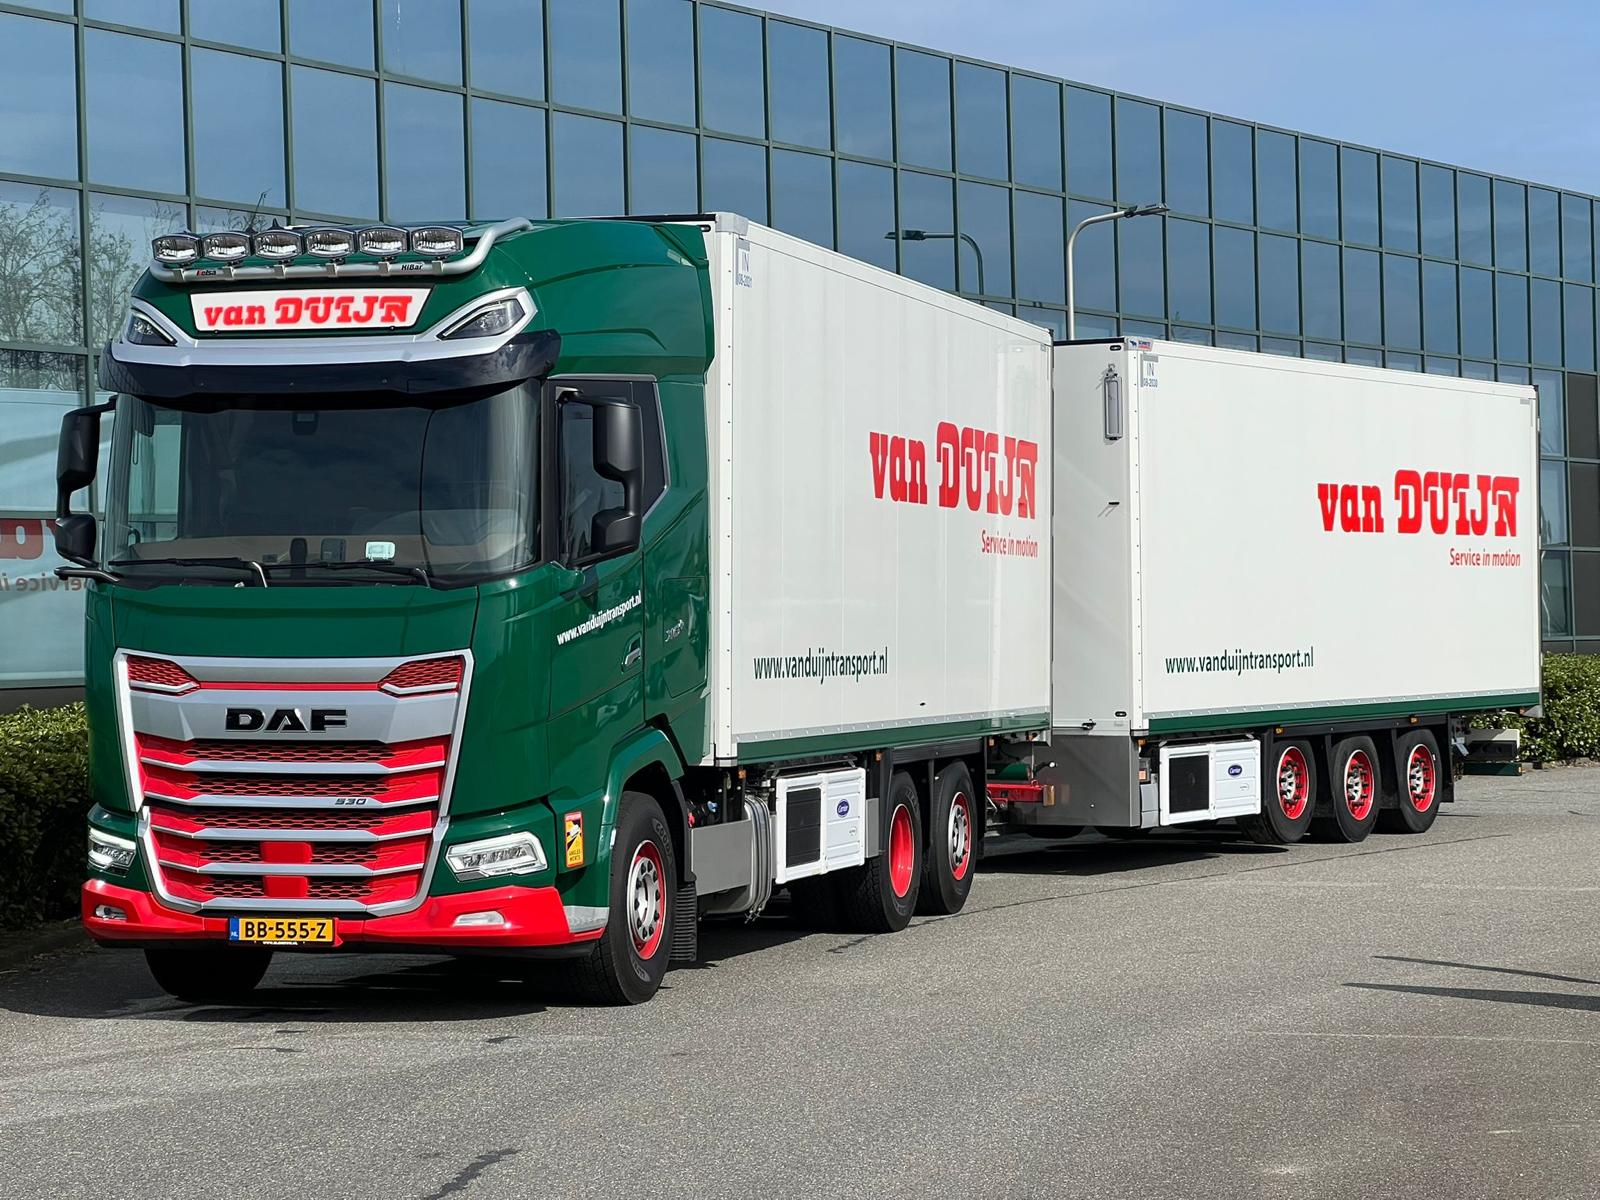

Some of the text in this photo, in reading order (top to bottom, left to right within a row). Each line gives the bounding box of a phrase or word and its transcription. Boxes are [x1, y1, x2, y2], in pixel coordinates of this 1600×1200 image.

[204, 295, 413, 326] van DUIJN
[869, 421, 1038, 520] van DUIJN
[1317, 469, 1520, 537] van DUIJN
[981, 529, 1038, 558] Service in motion
[1449, 547, 1521, 567] Service in motion
[556, 589, 642, 646] www.vanduijntransport.nl
[753, 646, 888, 685] www.vanduijntransport.nl
[1165, 645, 1314, 677] www.vanduijntransport.nl
[225, 707, 348, 733] DAF
[335, 797, 367, 805] 530
[245, 920, 327, 939] BB-555-Z
